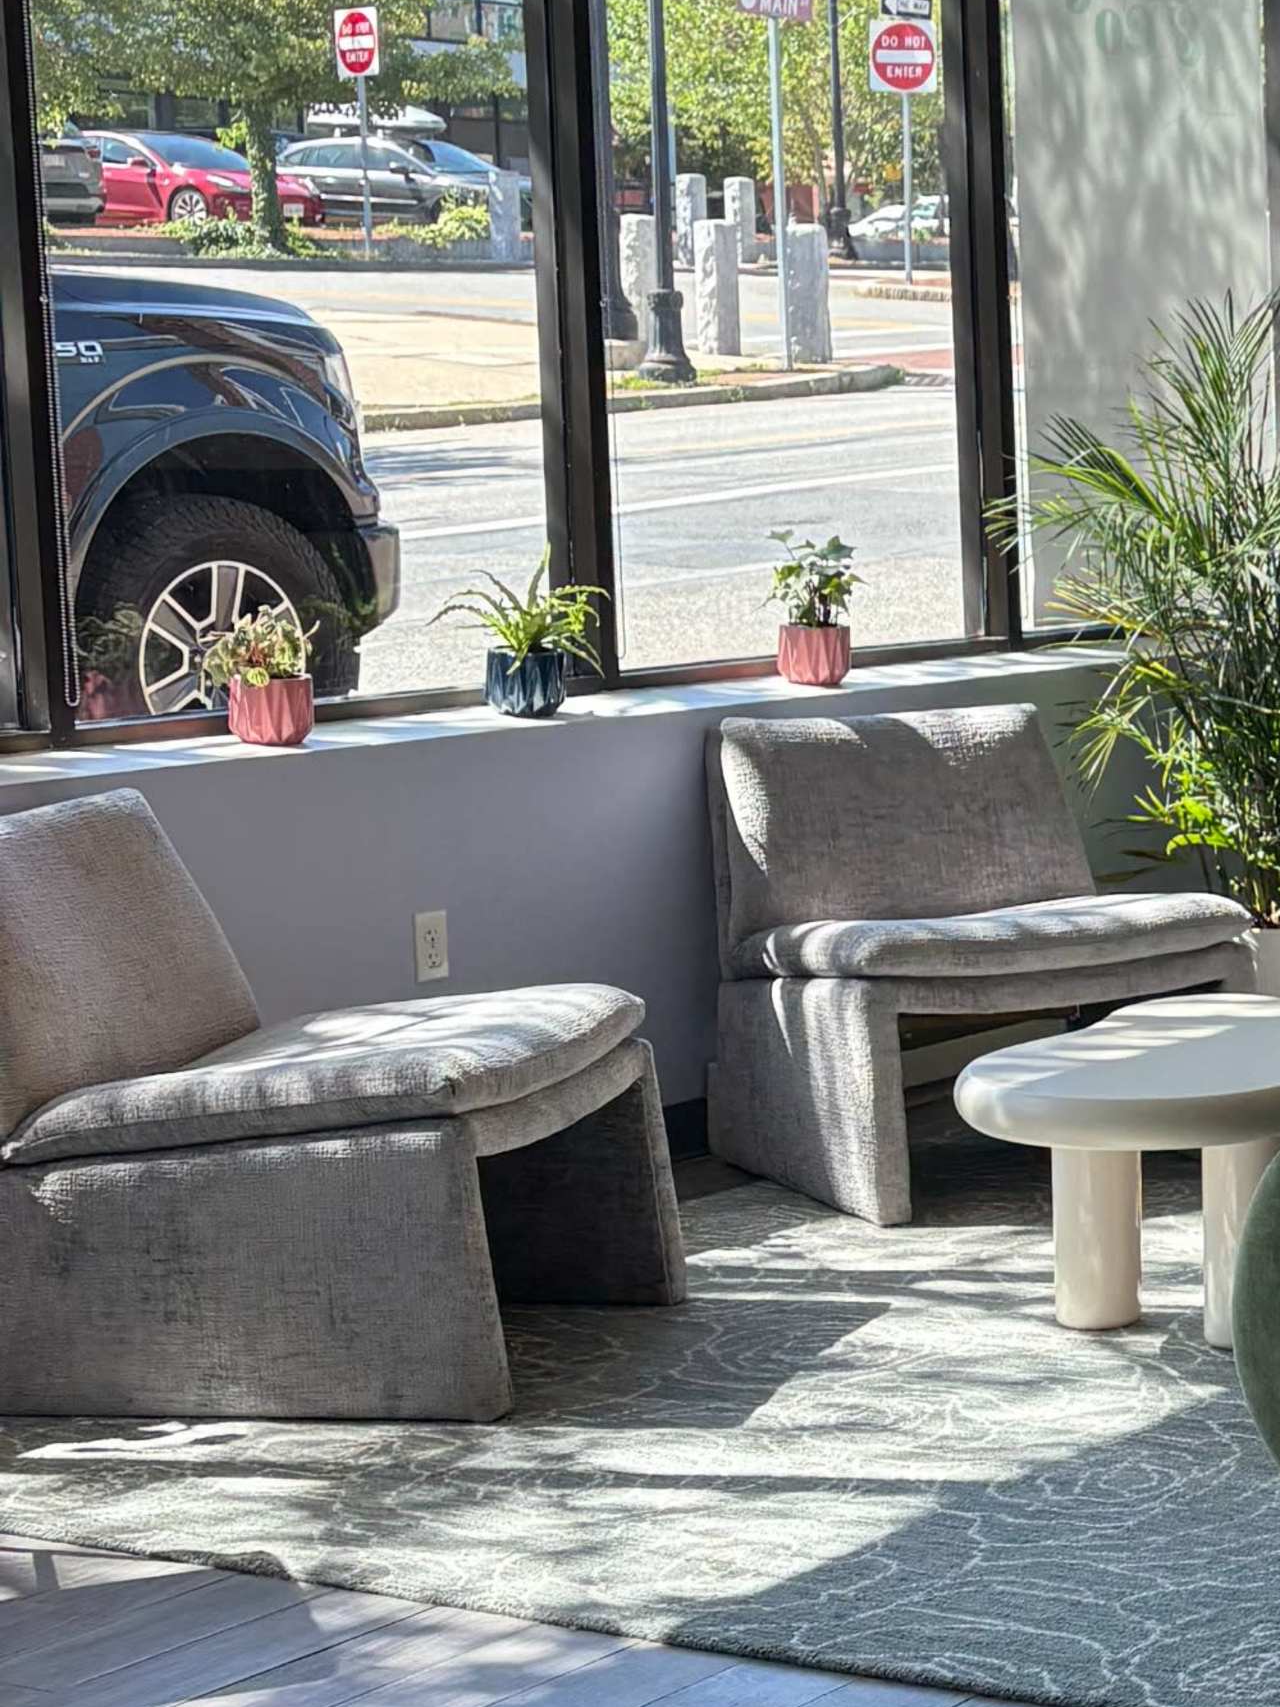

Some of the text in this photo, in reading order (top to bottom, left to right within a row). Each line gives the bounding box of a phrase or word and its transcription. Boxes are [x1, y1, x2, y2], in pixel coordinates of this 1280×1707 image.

[881, 35, 926, 48] DO NOT
[886, 65, 923, 79] ENTER
